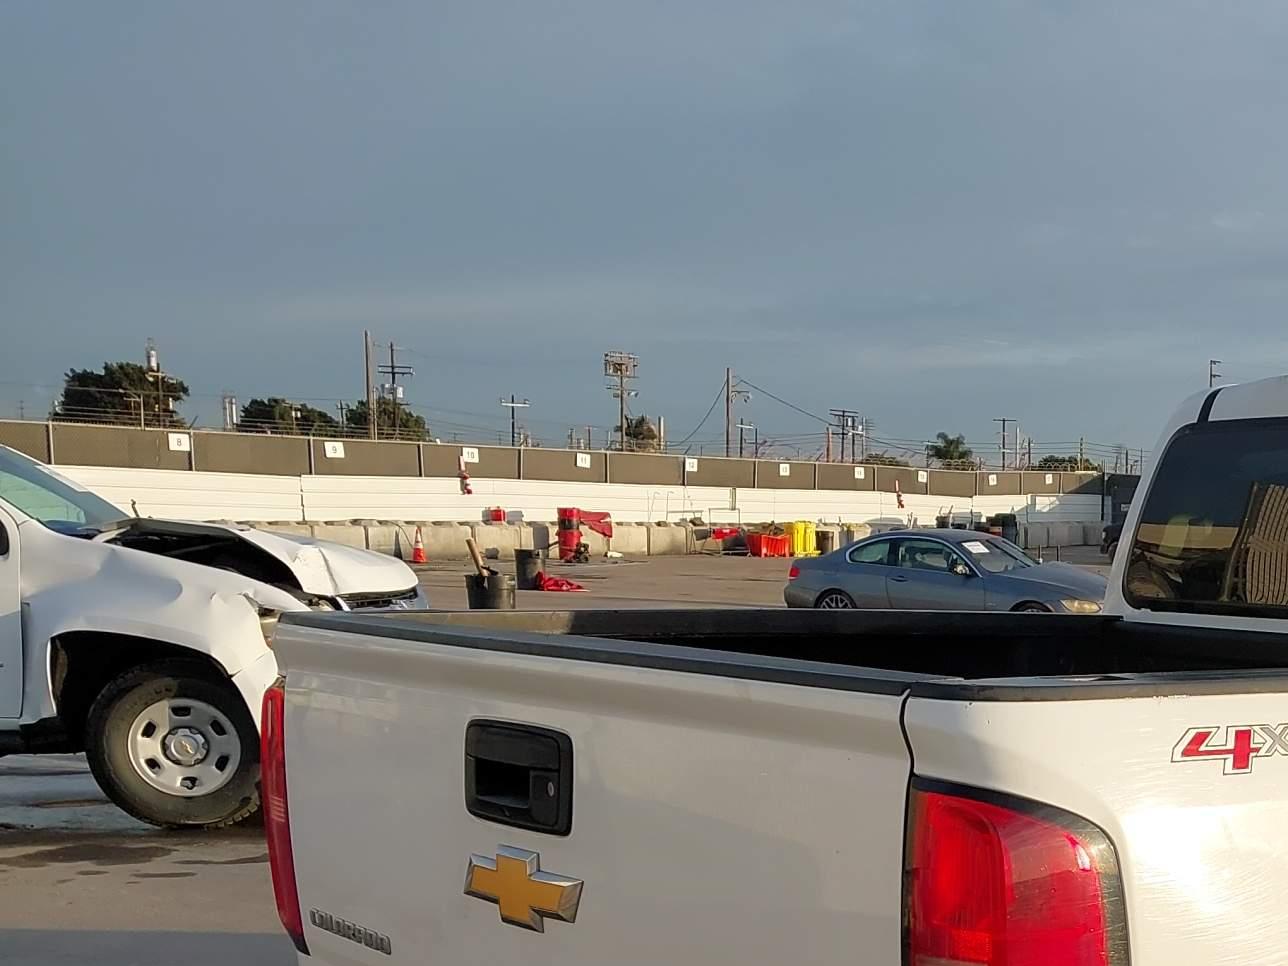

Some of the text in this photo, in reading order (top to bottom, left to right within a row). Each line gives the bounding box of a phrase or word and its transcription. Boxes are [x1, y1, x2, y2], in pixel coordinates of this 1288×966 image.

[176, 438, 182, 447] 8
[331, 446, 338, 454] 9
[467, 451, 475, 459] 10
[580, 456, 587, 465] 11
